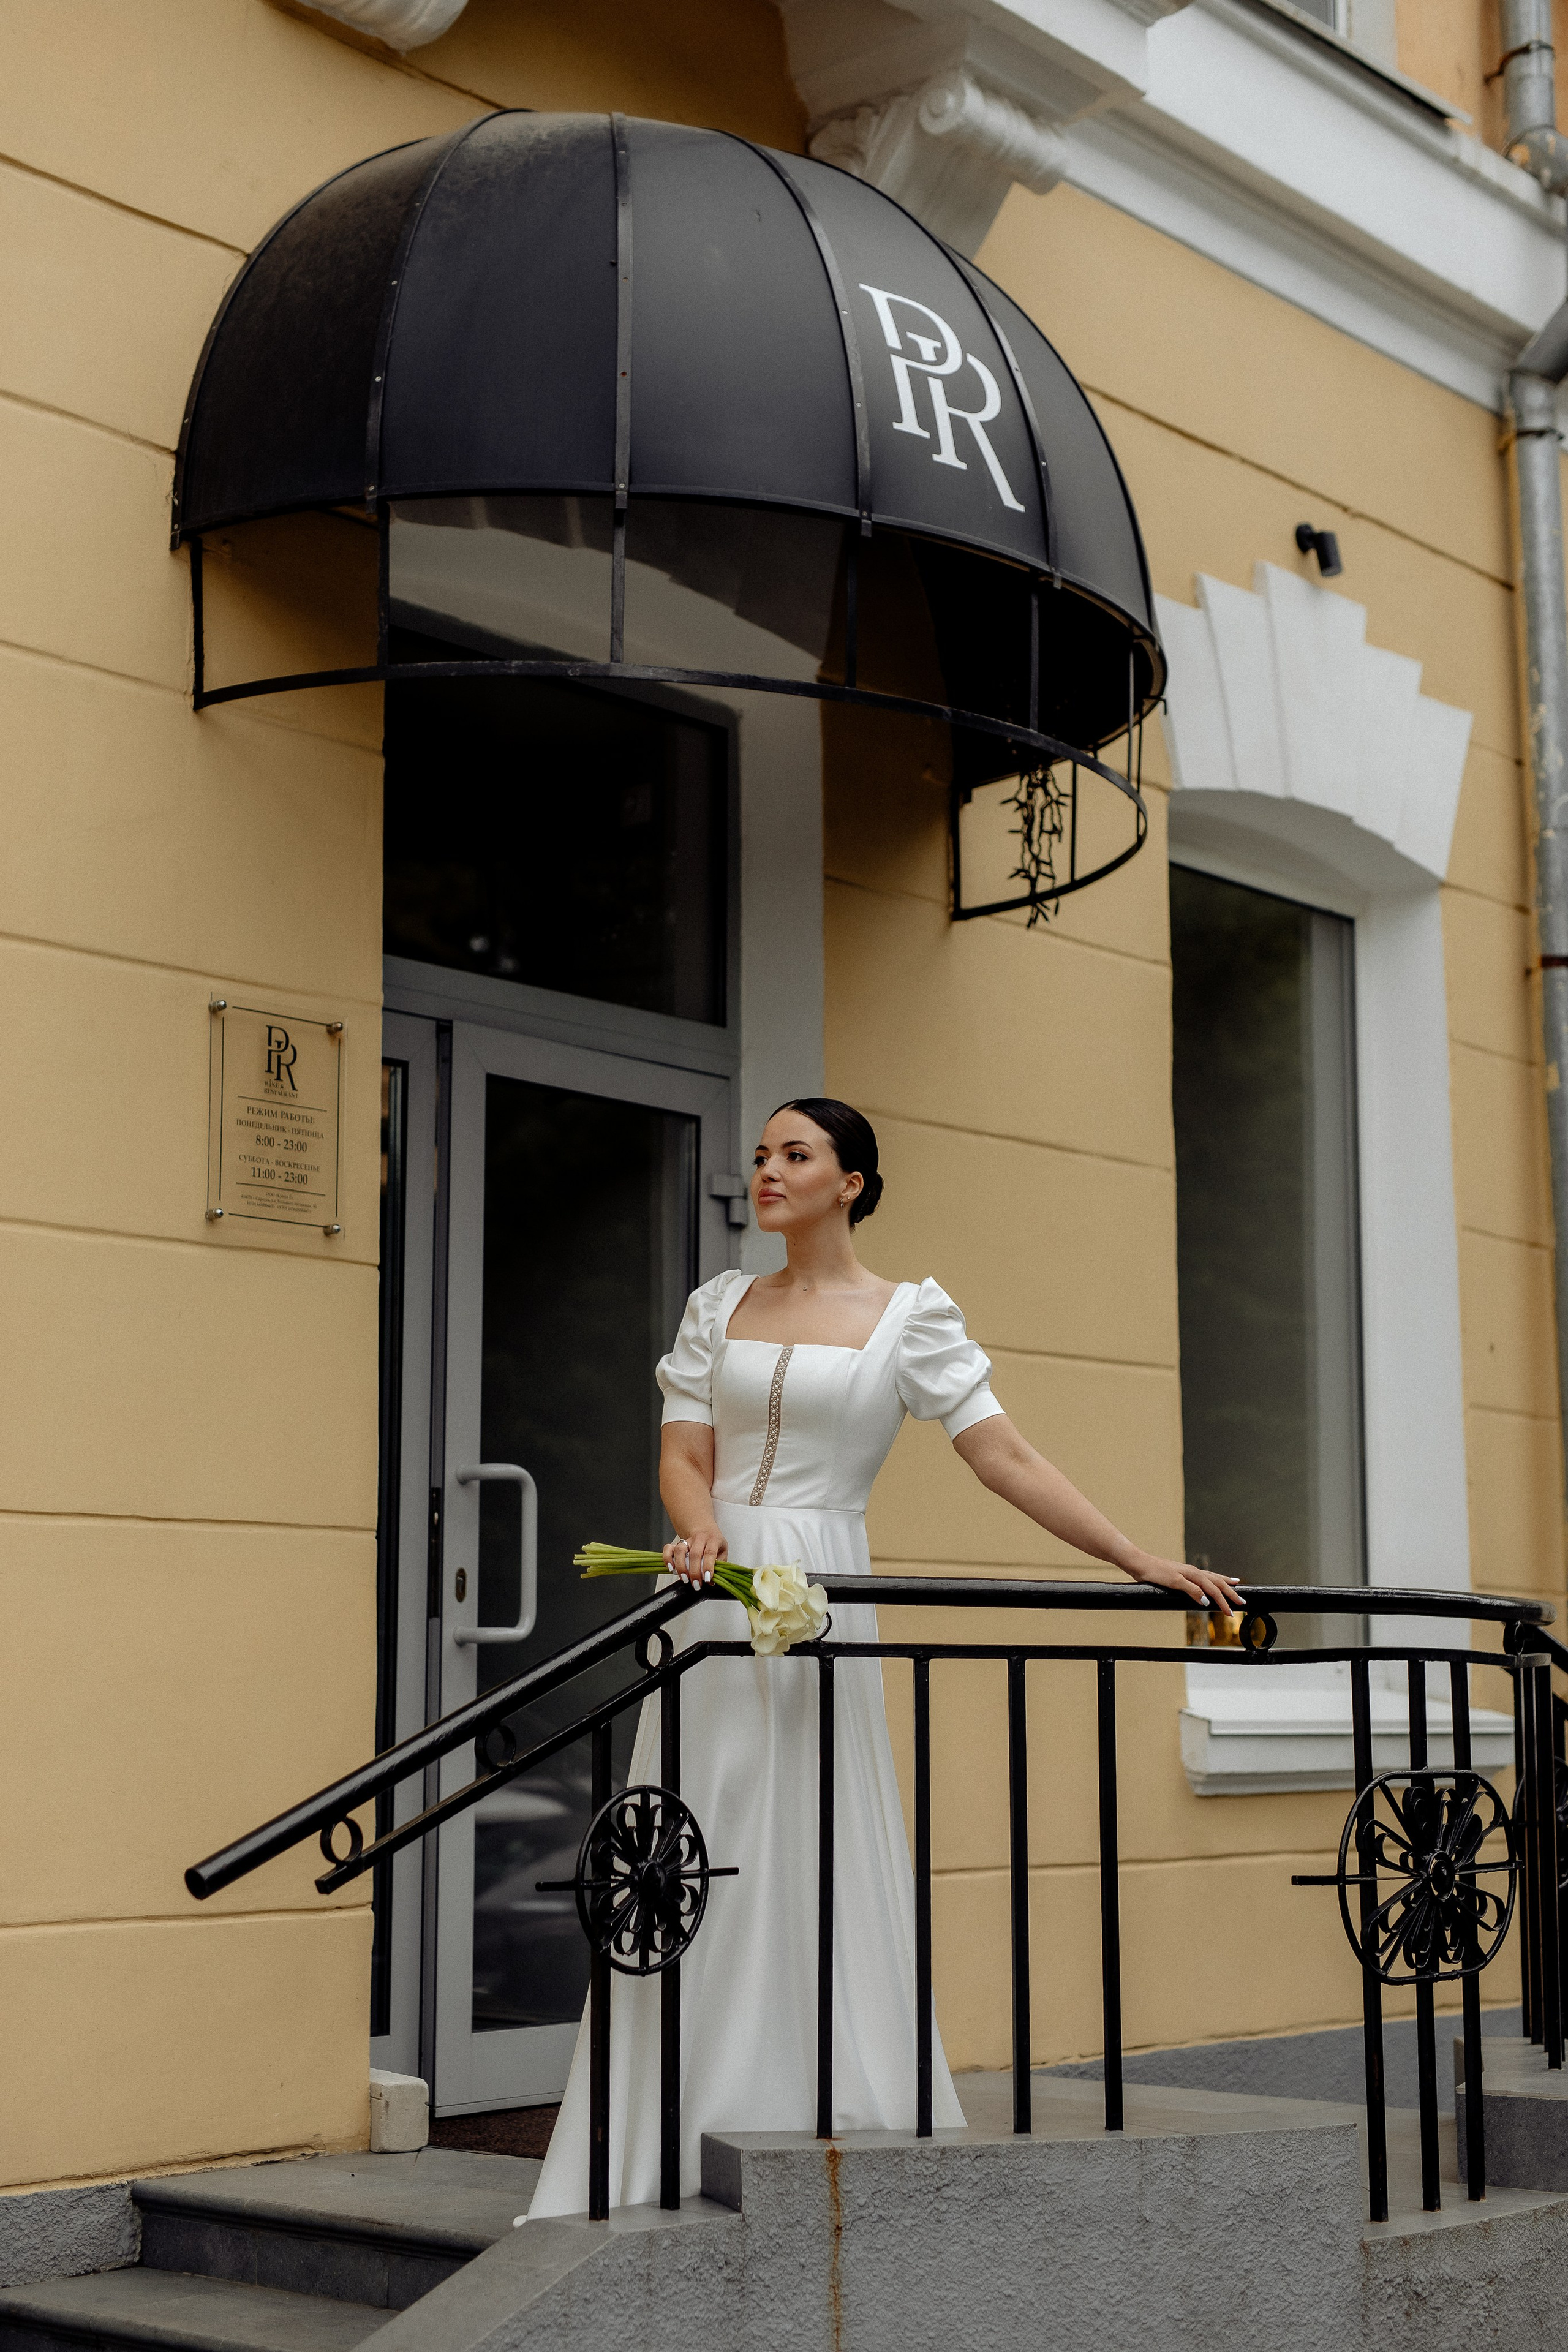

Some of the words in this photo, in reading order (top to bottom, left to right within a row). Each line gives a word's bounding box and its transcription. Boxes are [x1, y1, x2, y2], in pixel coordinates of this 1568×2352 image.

[858, 282, 1025, 513] PR
[265, 1024, 298, 1091] PR
[264, 1087, 298, 1099] RESTAURANT
[247, 1106, 277, 1118] РЕЖИМ
[281, 1110, 315, 1124] РАБОТЫ:
[236, 1118, 287, 1133] ПОНЕДЕЛЬНИК
[292, 1127, 324, 1139] ПЯТНИЦА
[255, 1134, 275, 1147] 8:00
[284, 1139, 307, 1152] 23:00
[239, 1154, 270, 1164] СУББОТА
[275, 1159, 320, 1172] ВОСКРЕСЕНЬЕ
[251, 1167, 276, 1180] 11:00
[284, 1171, 308, 1185] 23:00
